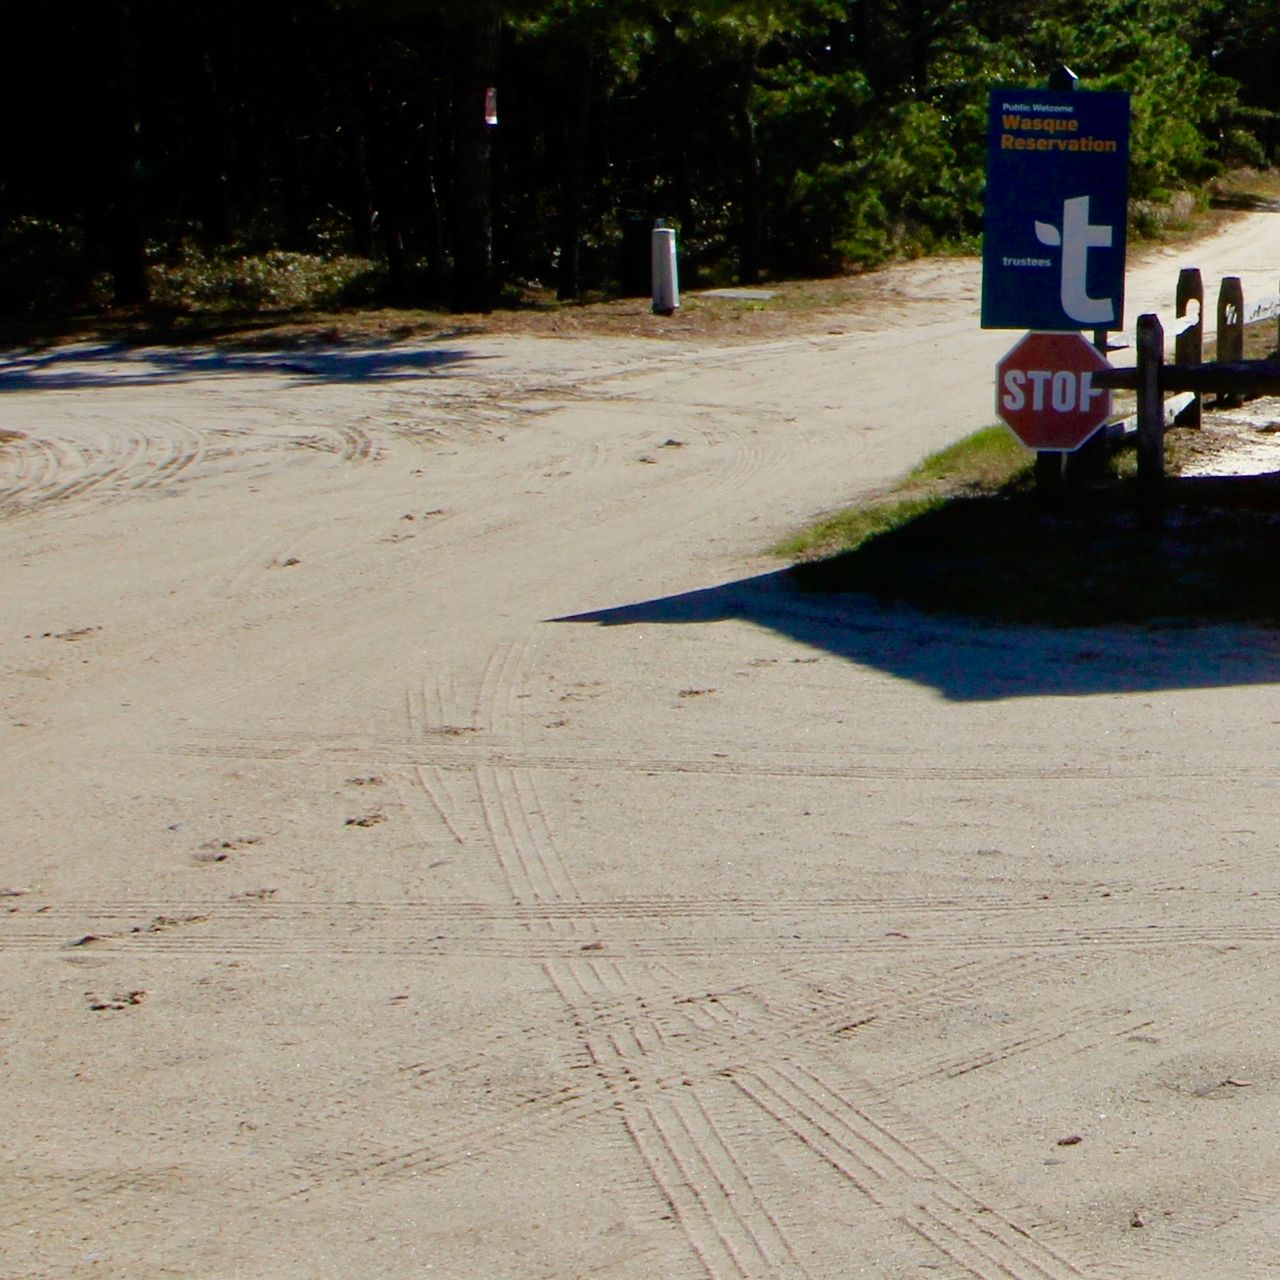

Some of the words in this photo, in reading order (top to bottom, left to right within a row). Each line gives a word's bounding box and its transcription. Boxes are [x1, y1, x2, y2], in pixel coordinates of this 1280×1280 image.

[1002, 103, 1031, 113] Public
[1032, 103, 1074, 114] Welcome
[1002, 114, 1079, 134] Wasque
[1001, 134, 1117, 152] Reservation
[1002, 255, 1052, 267] trustees
